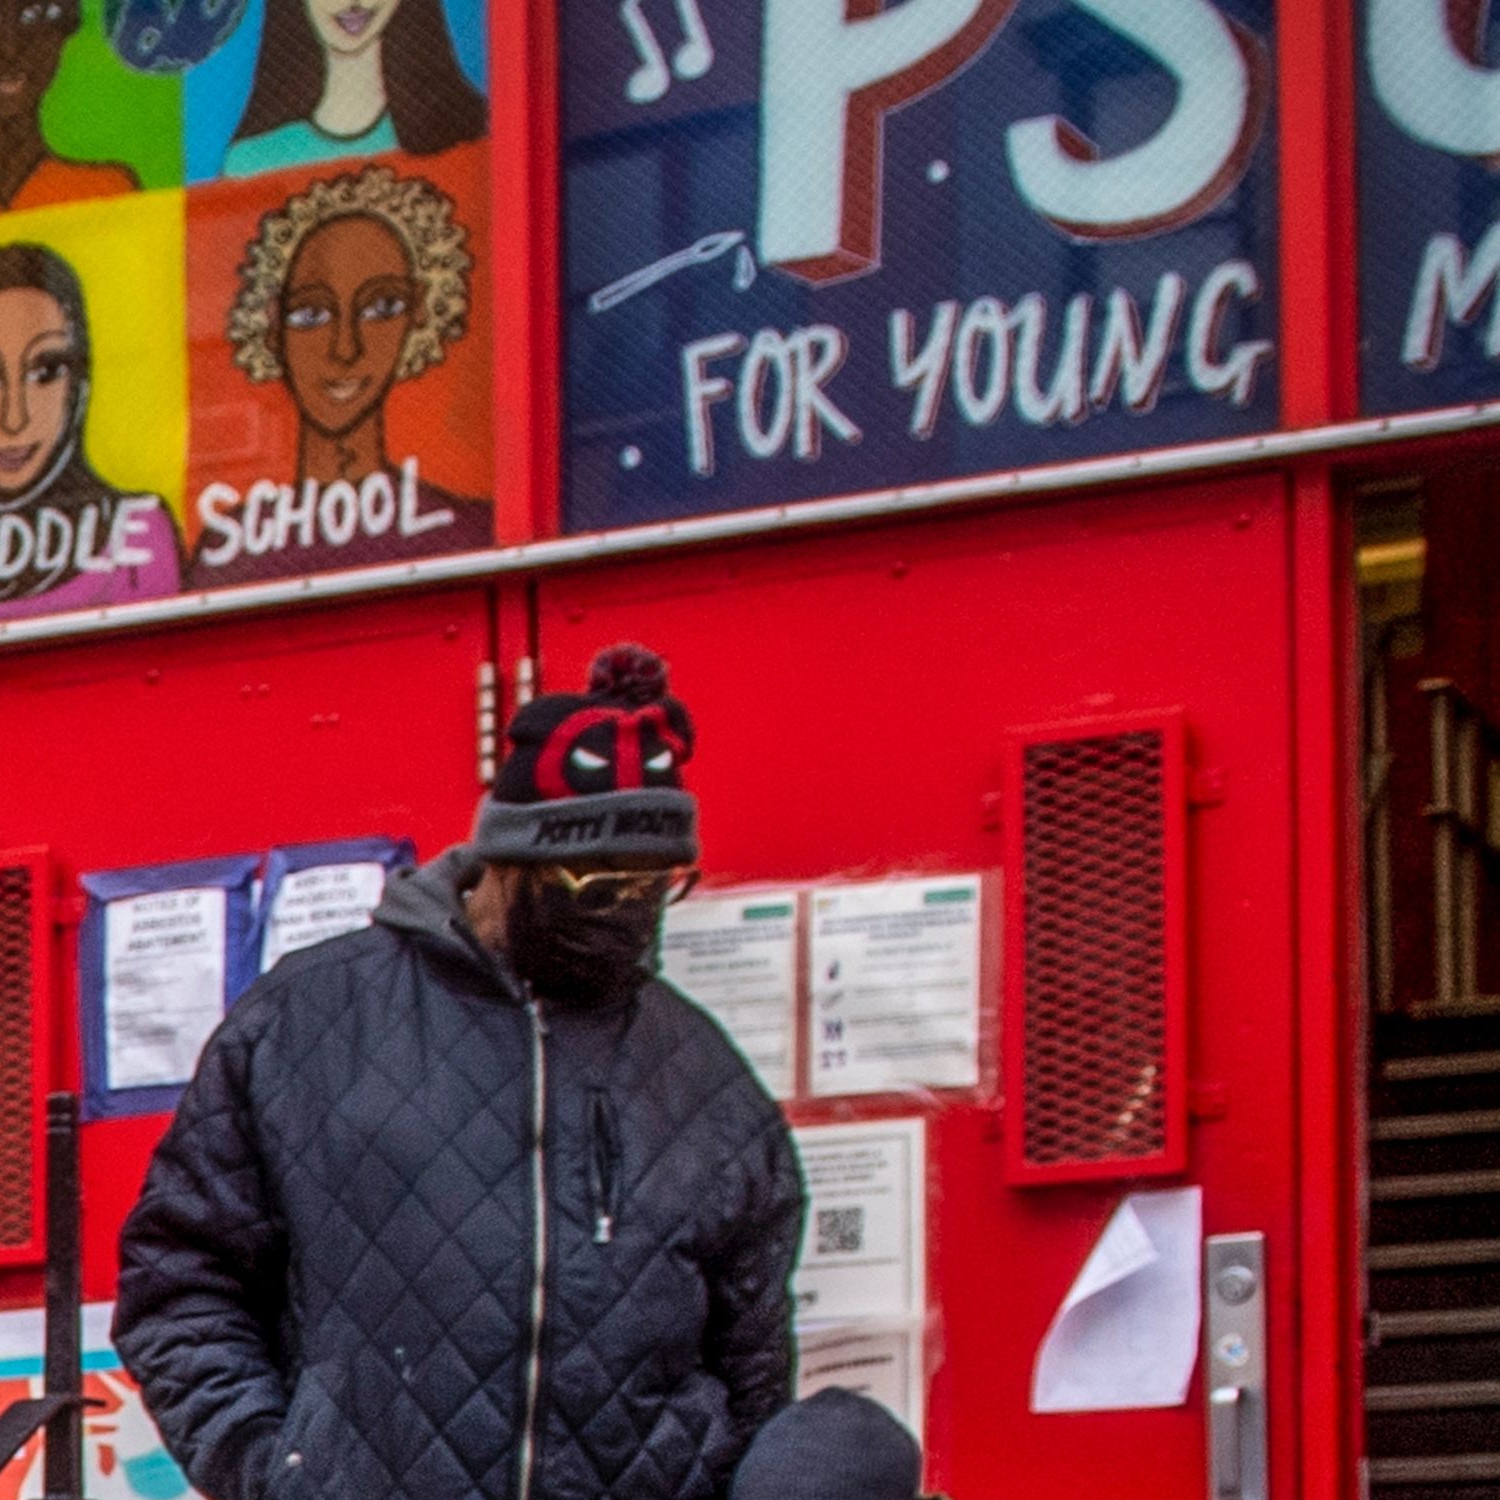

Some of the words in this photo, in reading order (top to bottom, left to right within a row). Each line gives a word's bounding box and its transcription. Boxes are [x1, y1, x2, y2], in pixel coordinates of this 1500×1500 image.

[681, 326, 864, 477] FOR
[888, 260, 1274, 440] YOUNG
[197, 456, 455, 567] SCHOOL
